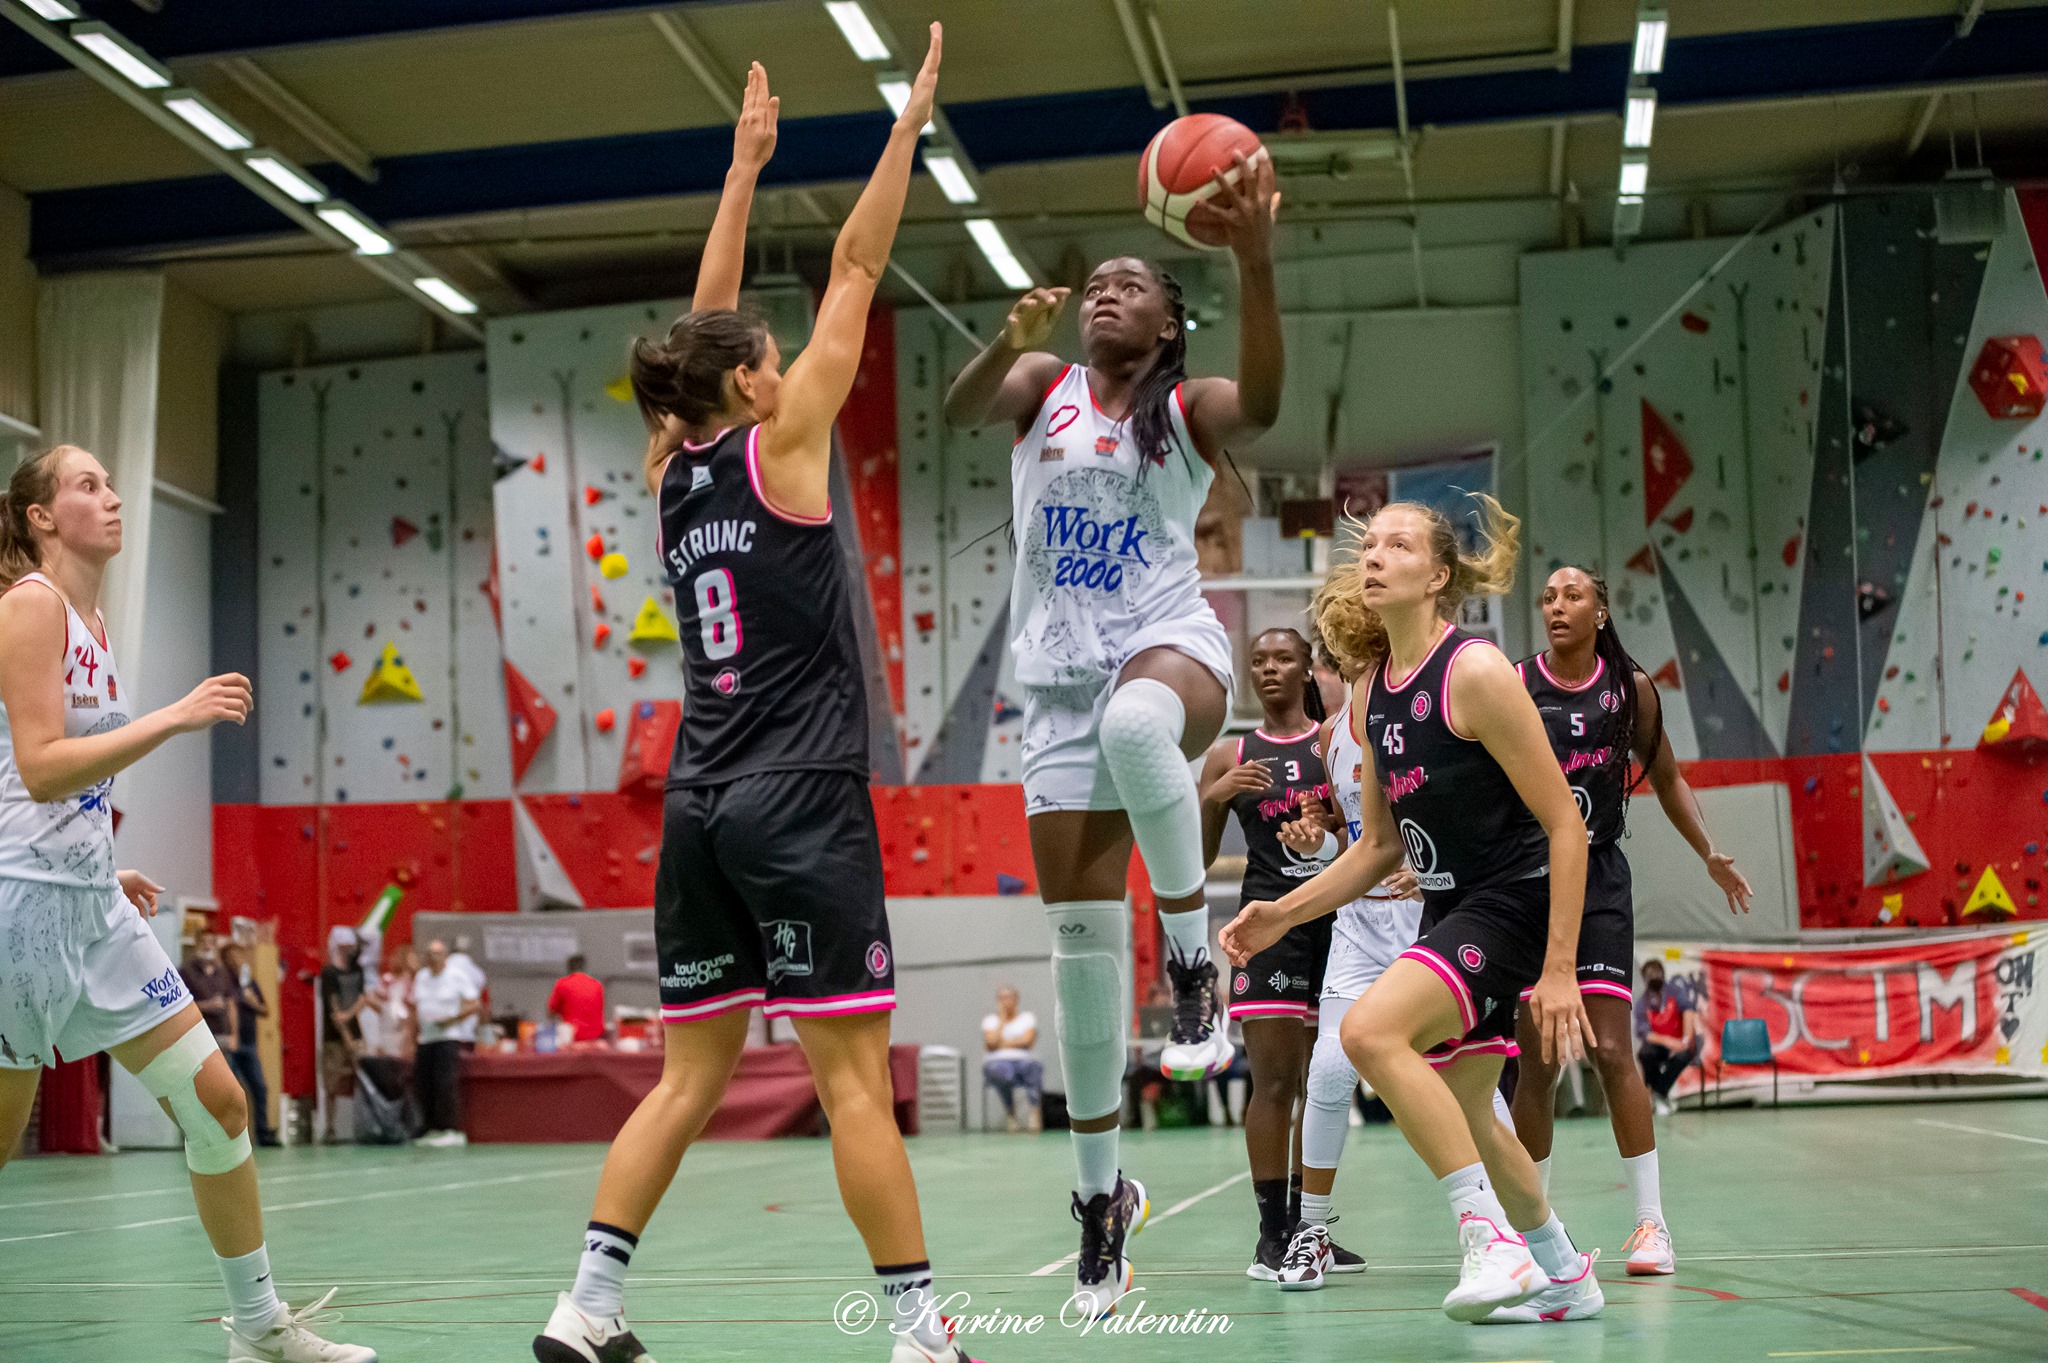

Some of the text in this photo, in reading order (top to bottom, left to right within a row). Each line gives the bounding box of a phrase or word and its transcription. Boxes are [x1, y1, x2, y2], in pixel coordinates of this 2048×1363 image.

[669, 519, 756, 577] STRUNC
[1043, 506, 1150, 568] Work
[1055, 556, 1123, 592] 2000
[694, 567, 743, 661] 8
[65, 644, 99, 688] 14
[71, 692, 99, 705] isère
[1382, 723, 1405, 755] 45
[1570, 713, 1586, 736] 5
[1285, 760, 1301, 781] 3
[1417, 876, 1452, 887] MOTION
[660, 967, 723, 990] métropole
[675, 953, 735, 974] toulouse
[140, 967, 180, 1000] Work
